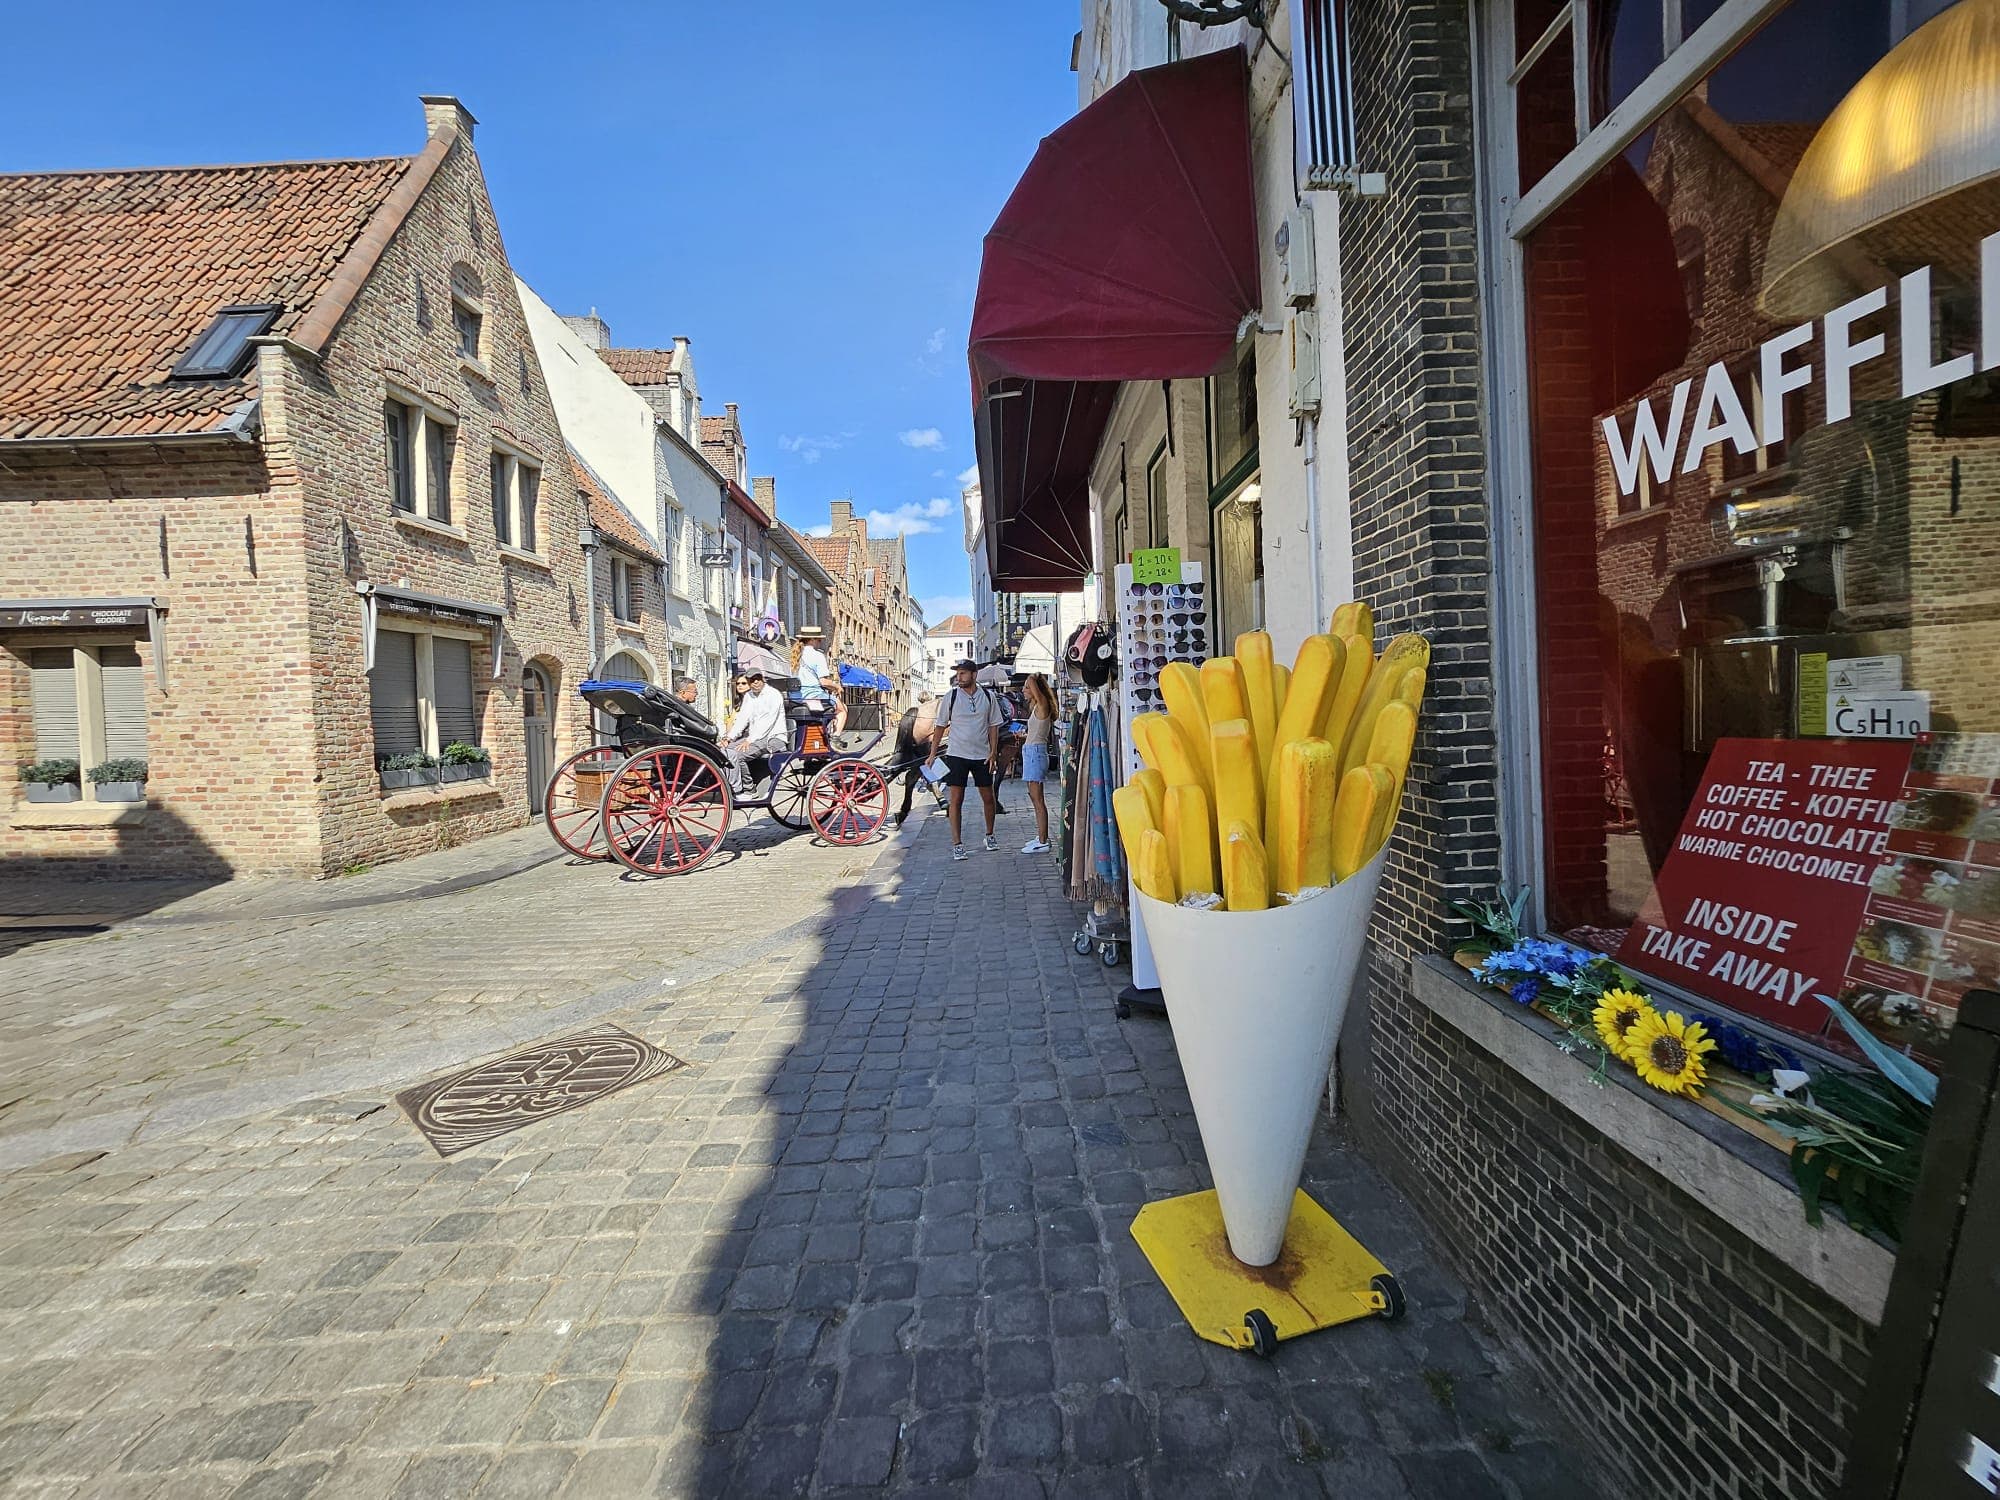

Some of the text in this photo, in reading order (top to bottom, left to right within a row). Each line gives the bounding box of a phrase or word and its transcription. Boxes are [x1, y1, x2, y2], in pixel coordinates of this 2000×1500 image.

[1602, 230, 2000, 496] WAFFL
[1706, 783, 1787, 811] COFFEE
[1746, 761, 1785, 783] TEA
[1808, 764, 1877, 791] THEE
[1695, 808, 1740, 832] HOT
[1741, 814, 1889, 856] CHOCOLATE
[1679, 833, 1746, 861] WARME
[1746, 845, 1874, 887] CHOCOMEL
[1684, 897, 1798, 953] INSIDE
[1640, 925, 1819, 1007] TAKE AWAY
